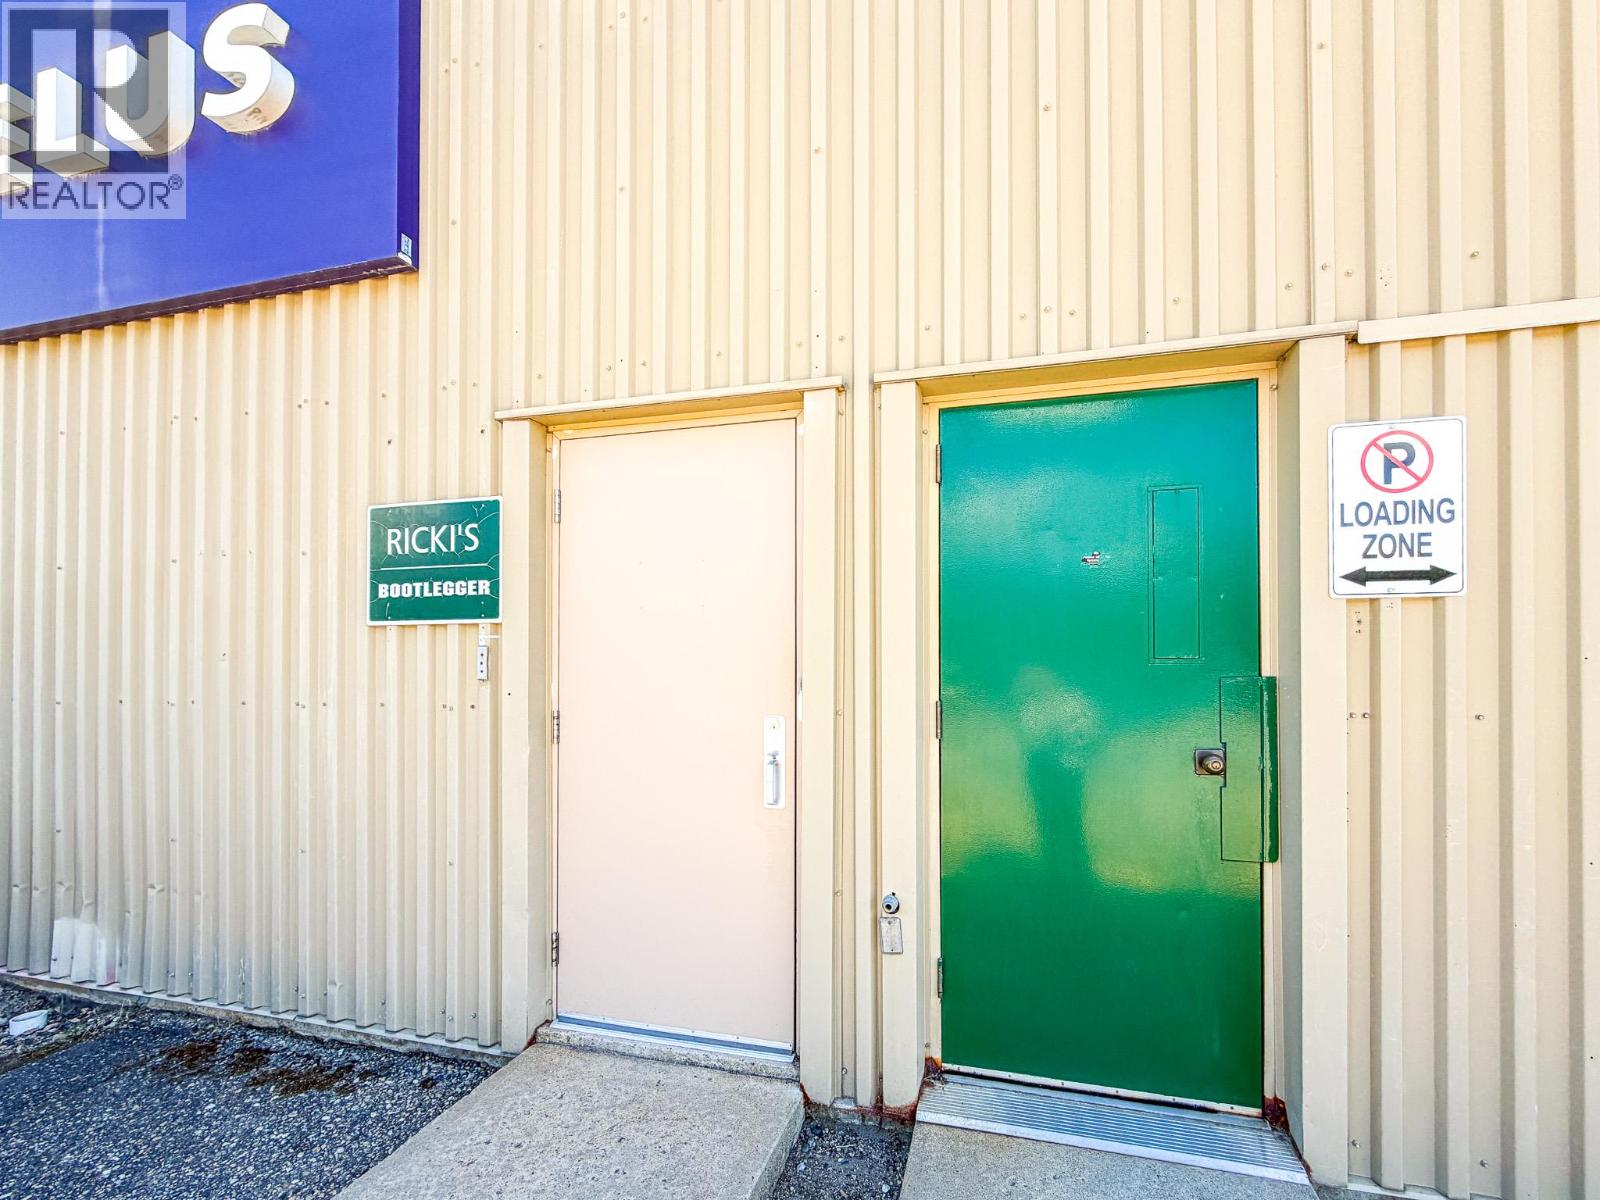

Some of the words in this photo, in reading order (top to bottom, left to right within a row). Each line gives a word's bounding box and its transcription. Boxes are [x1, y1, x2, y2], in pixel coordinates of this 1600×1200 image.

[0, 2, 296, 195] LUS
[1340, 497, 1456, 528] LOADING
[387, 523, 479, 555] RICKI'S
[1362, 532, 1433, 559] ZONE
[378, 579, 490, 598] BOOTLEGGER
